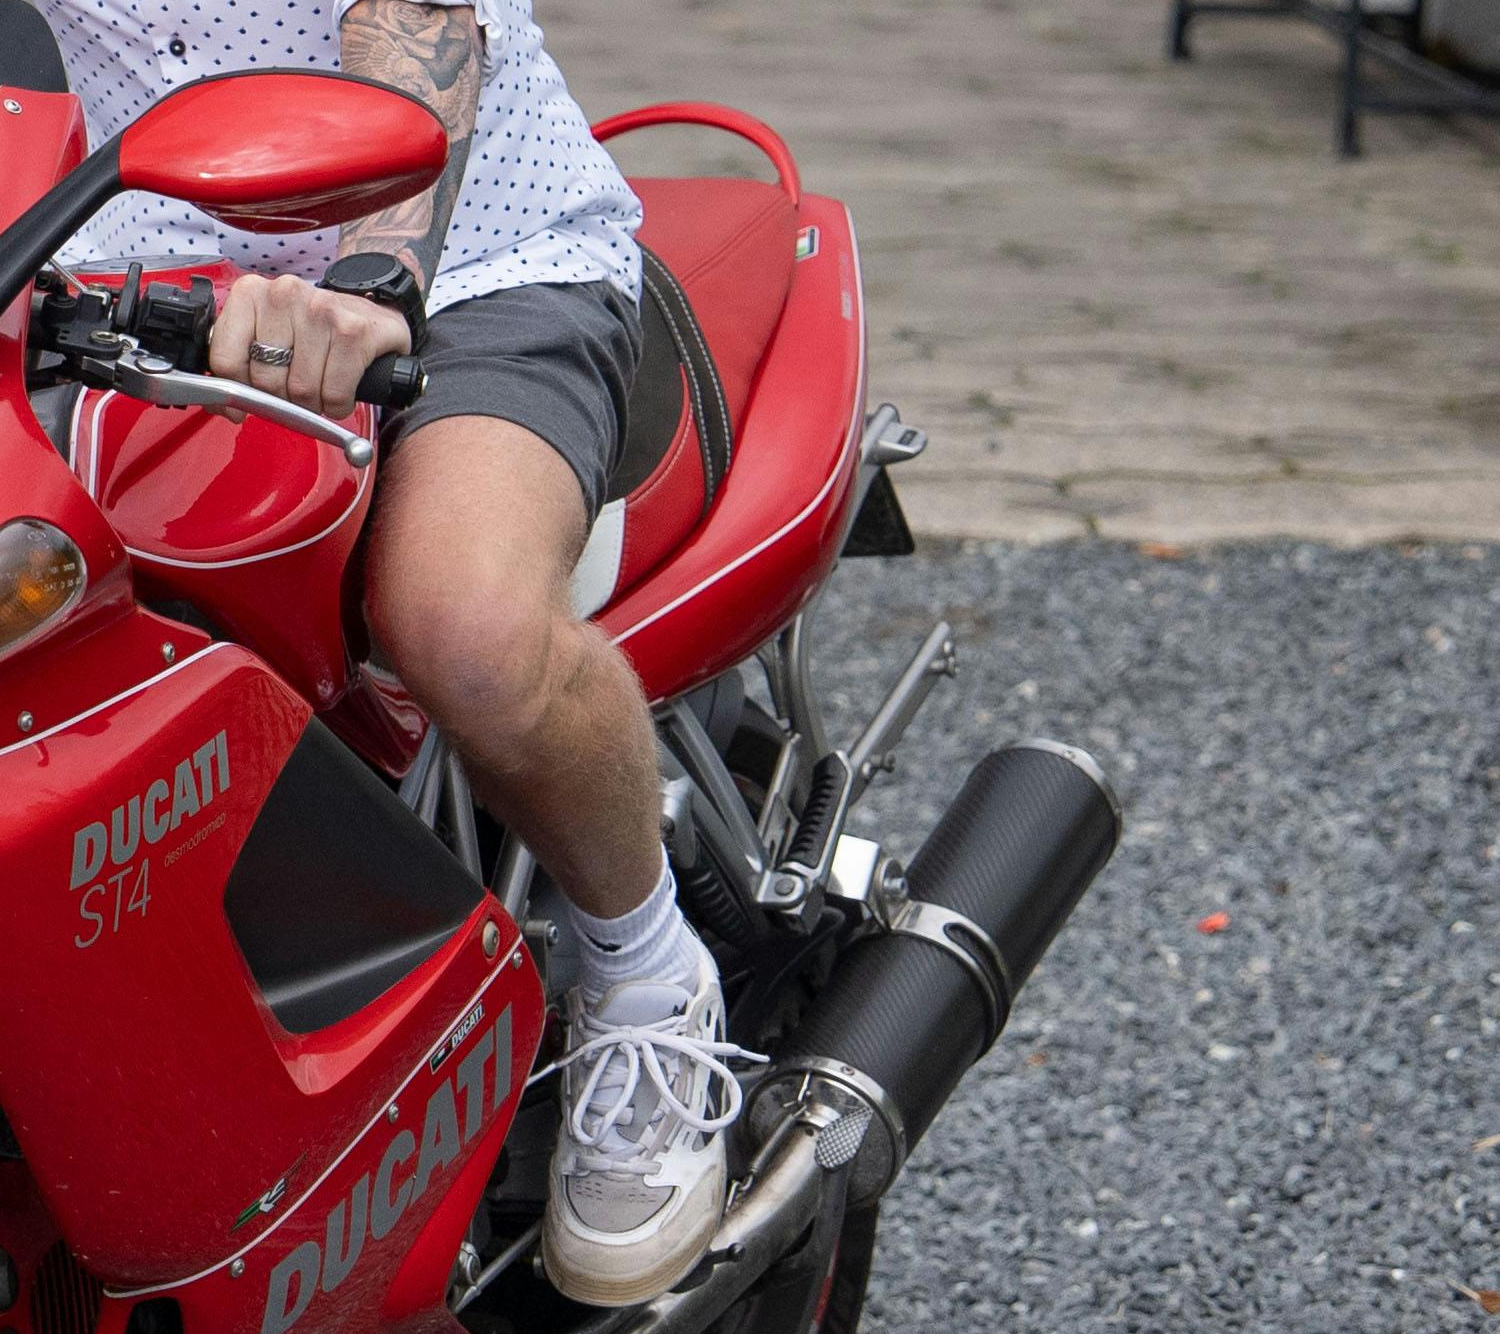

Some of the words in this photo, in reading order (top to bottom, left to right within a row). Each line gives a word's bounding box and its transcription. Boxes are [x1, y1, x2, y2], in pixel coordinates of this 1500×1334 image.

[70, 729, 230, 891] DUCATI
[74, 858, 151, 949] ST4
[452, 1003, 483, 1049] DUCATI
